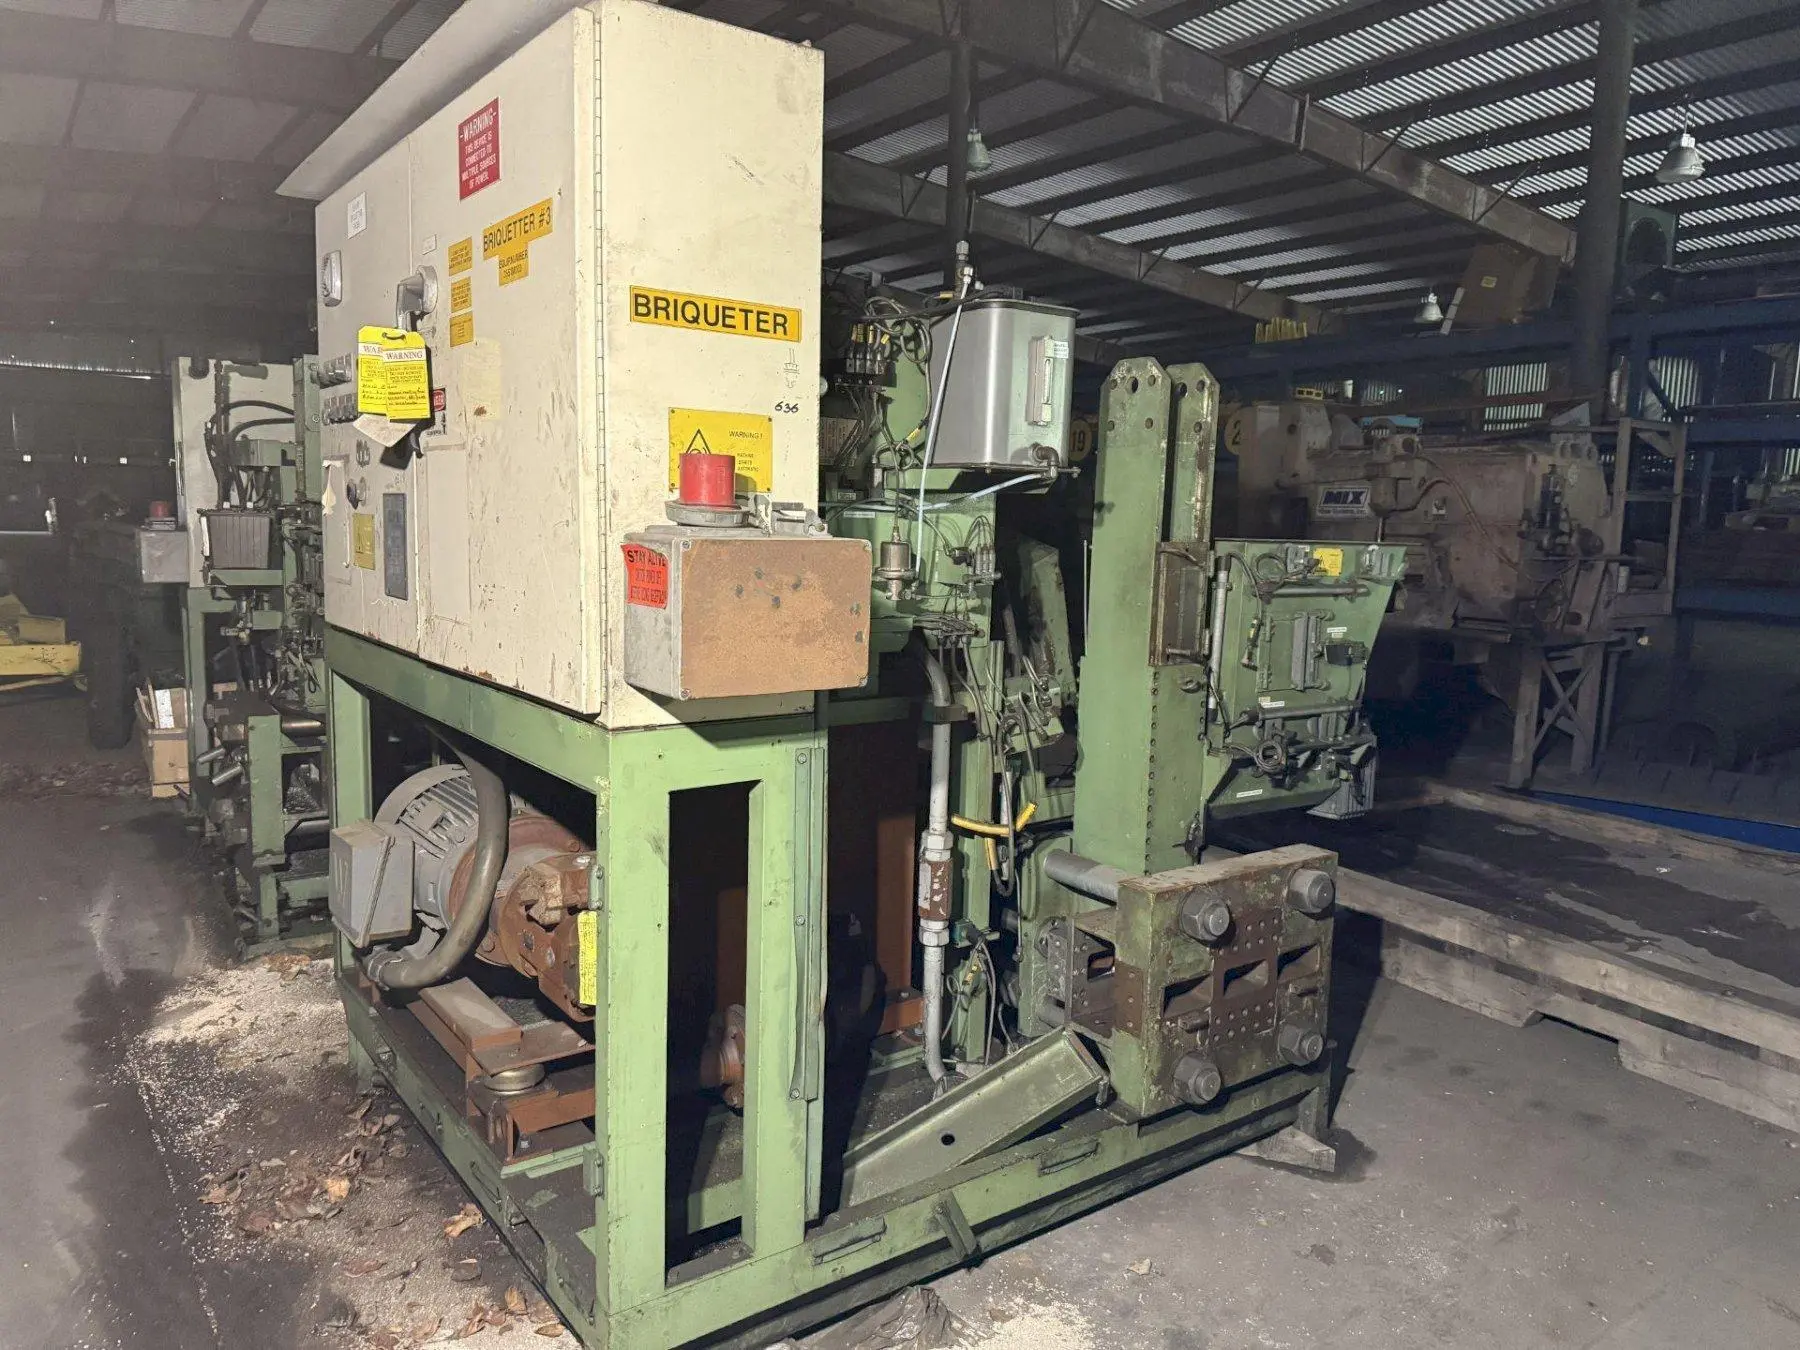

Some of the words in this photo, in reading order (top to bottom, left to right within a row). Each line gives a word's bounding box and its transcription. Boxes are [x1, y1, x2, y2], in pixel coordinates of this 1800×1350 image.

[483, 212, 535, 253] BRIQUETTER
[538, 206, 551, 229] #3
[633, 292, 789, 337] BRIQUETER
[386, 350, 423, 360] WARNING
[774, 400, 799, 414] 636
[1072, 430, 1086, 452] 19
[627, 549, 646, 563] STAY
